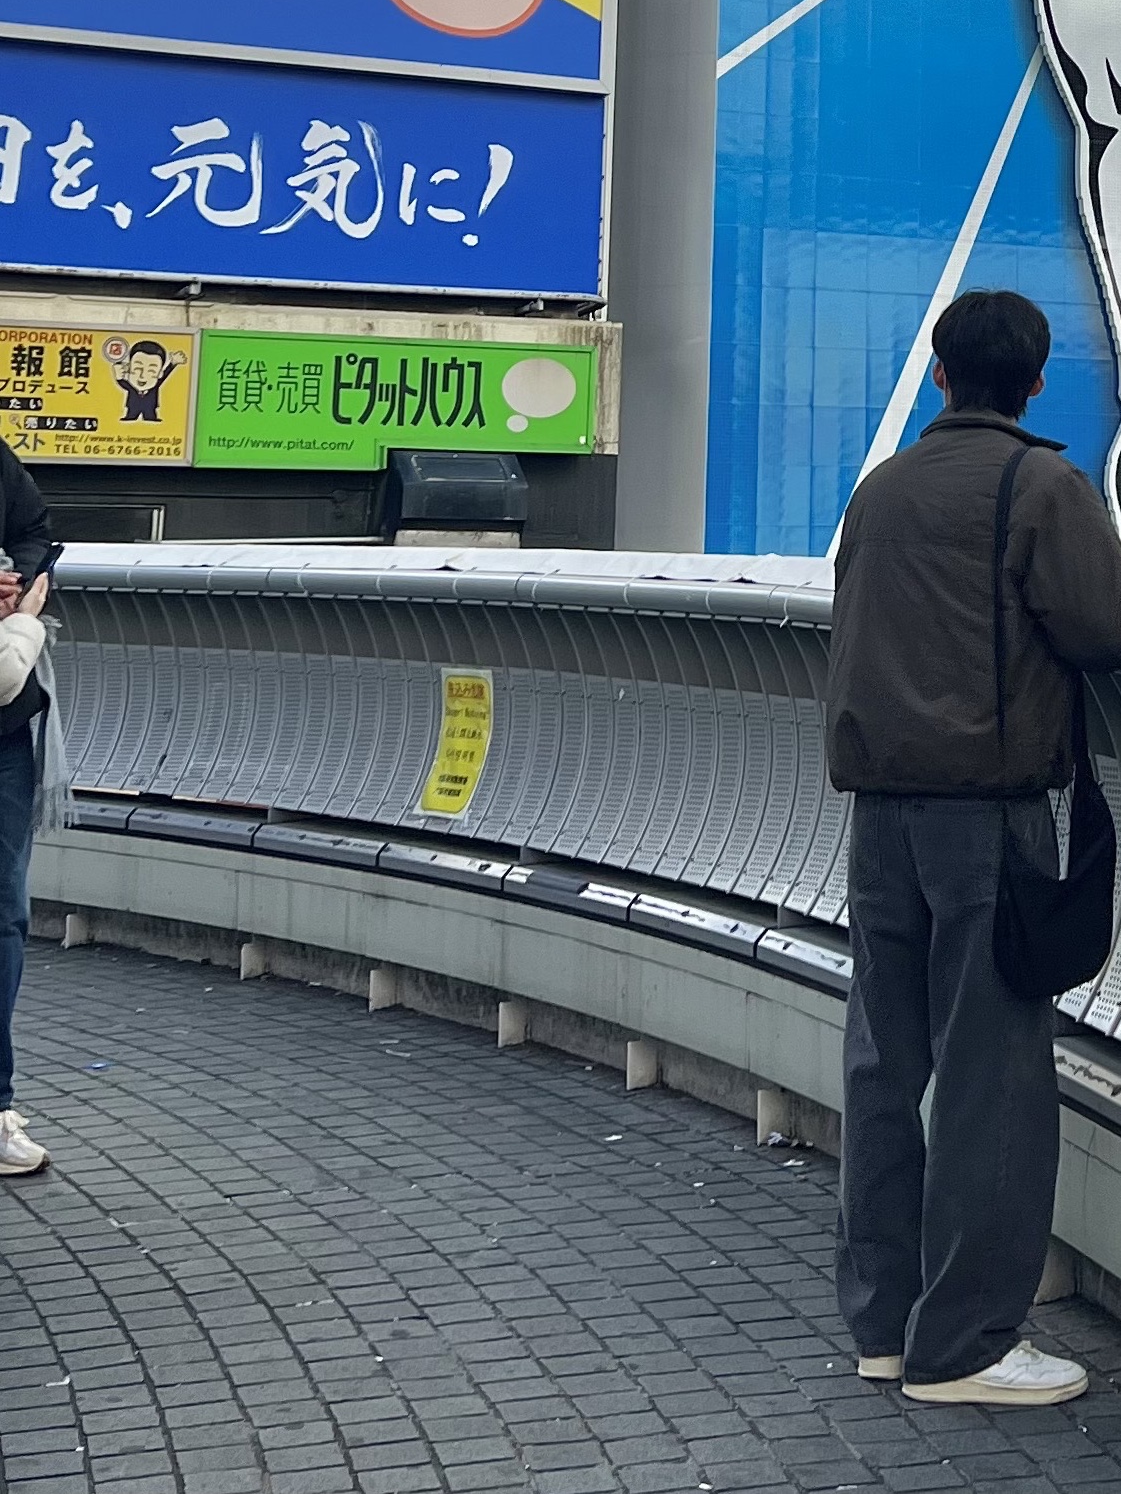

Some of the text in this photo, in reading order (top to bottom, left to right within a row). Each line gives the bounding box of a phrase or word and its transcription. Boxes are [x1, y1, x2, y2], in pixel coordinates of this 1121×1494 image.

[216, 352, 486, 429] 賃貸・売買 ピタットハウス
[4, 432, 46, 452] スト
[55, 443, 181, 457] TEL 06-6766-2016
[208, 435, 354, 451] http://www.pitat.com/
